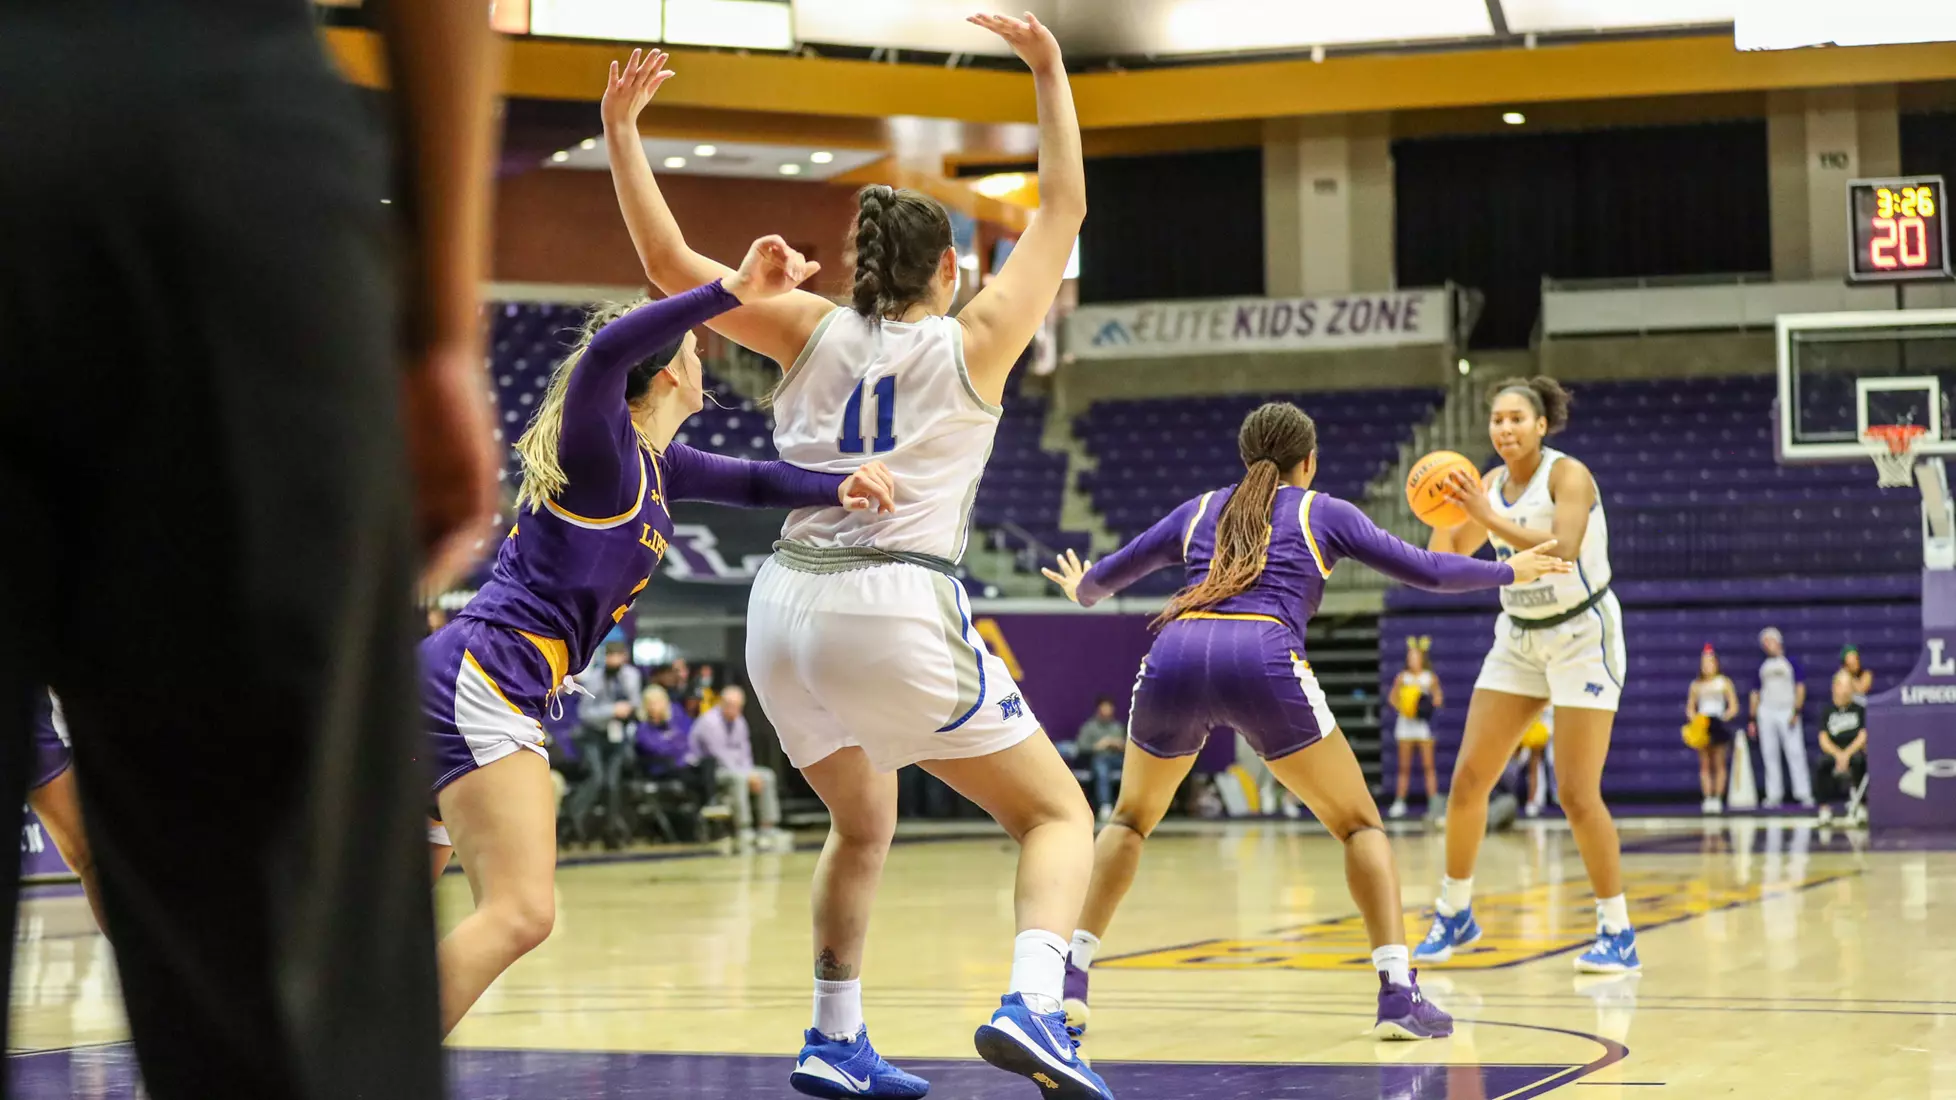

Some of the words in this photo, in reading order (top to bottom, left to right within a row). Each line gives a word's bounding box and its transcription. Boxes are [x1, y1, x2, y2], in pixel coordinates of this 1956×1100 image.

[1876, 186, 1935, 219] 3:26
[1870, 216, 1928, 268] 20
[1134, 305, 1229, 343] ELITE
[1231, 302, 1319, 340] KIDS
[1325, 295, 1425, 337] ZONE
[837, 373, 897, 455] 11
